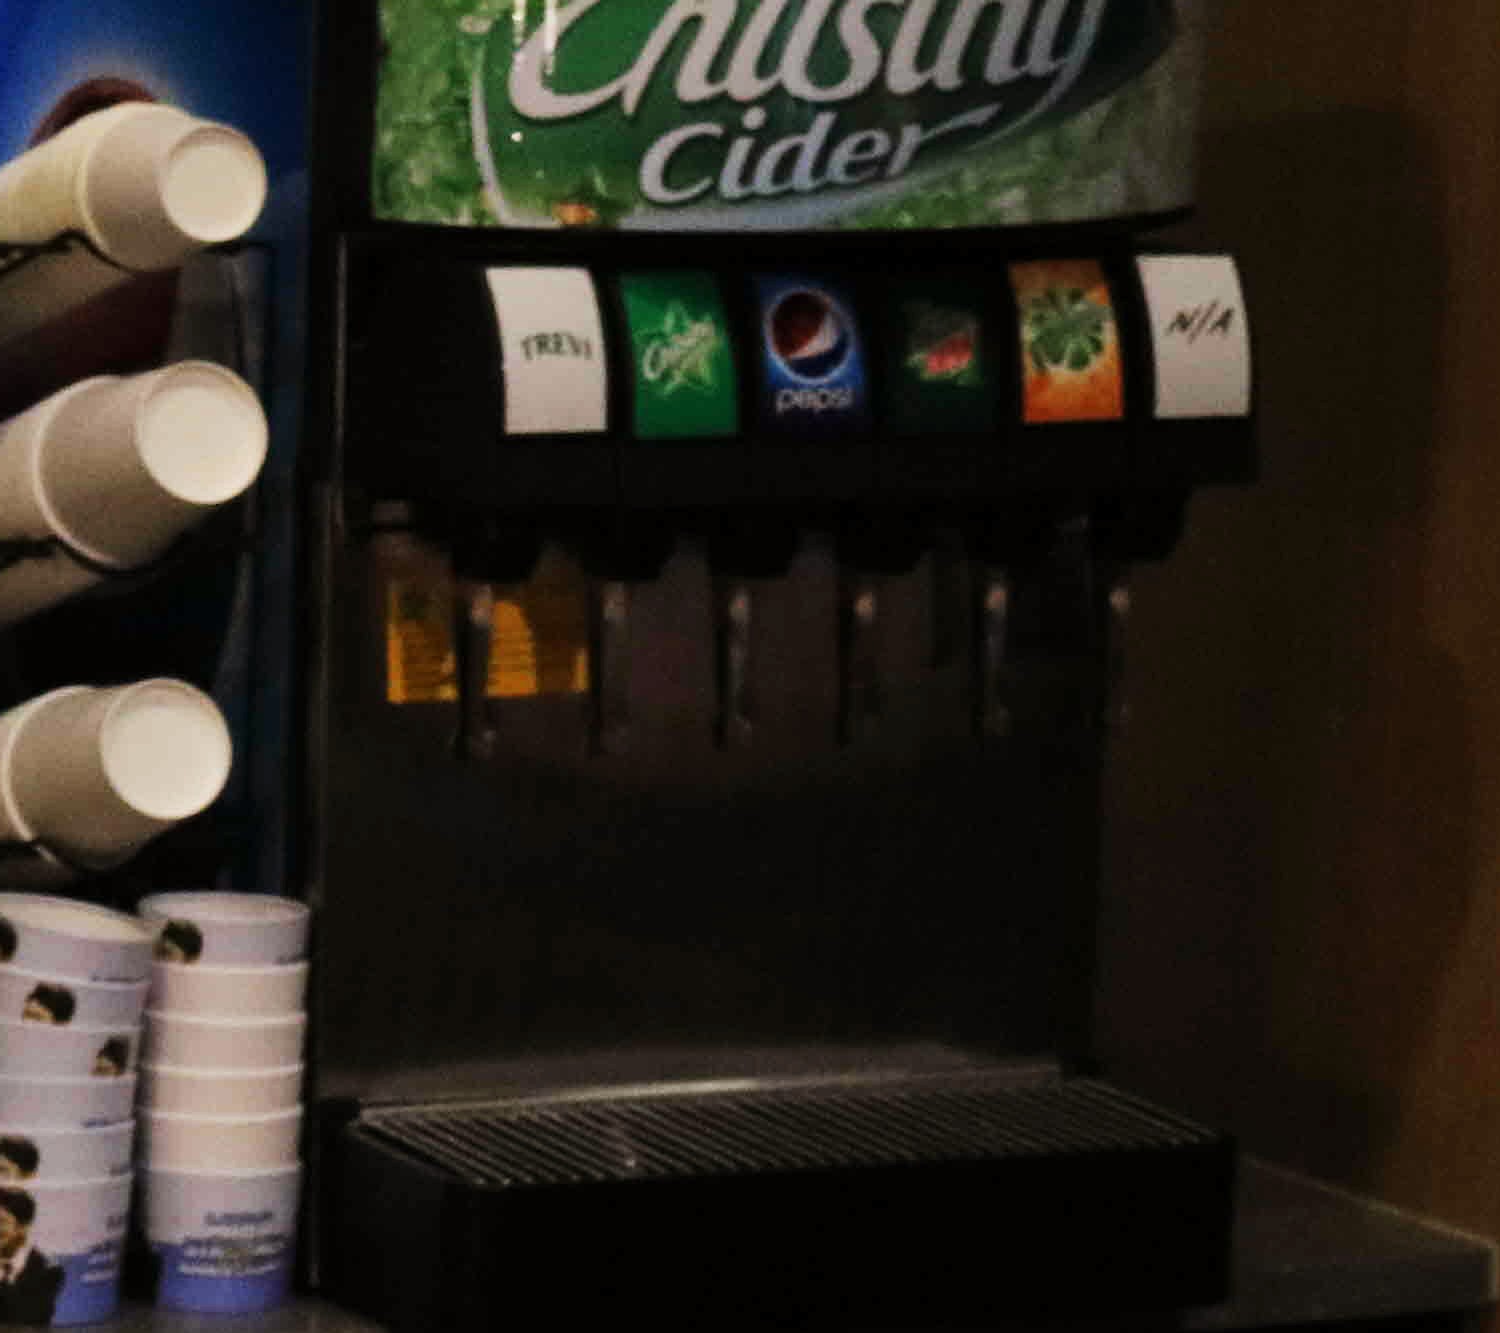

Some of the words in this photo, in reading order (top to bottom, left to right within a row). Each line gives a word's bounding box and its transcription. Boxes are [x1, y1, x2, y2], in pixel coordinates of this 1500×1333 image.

[638, 106, 999, 203] Cider
[1167, 300, 1235, 344] N/A
[775, 387, 854, 415] pepsi
